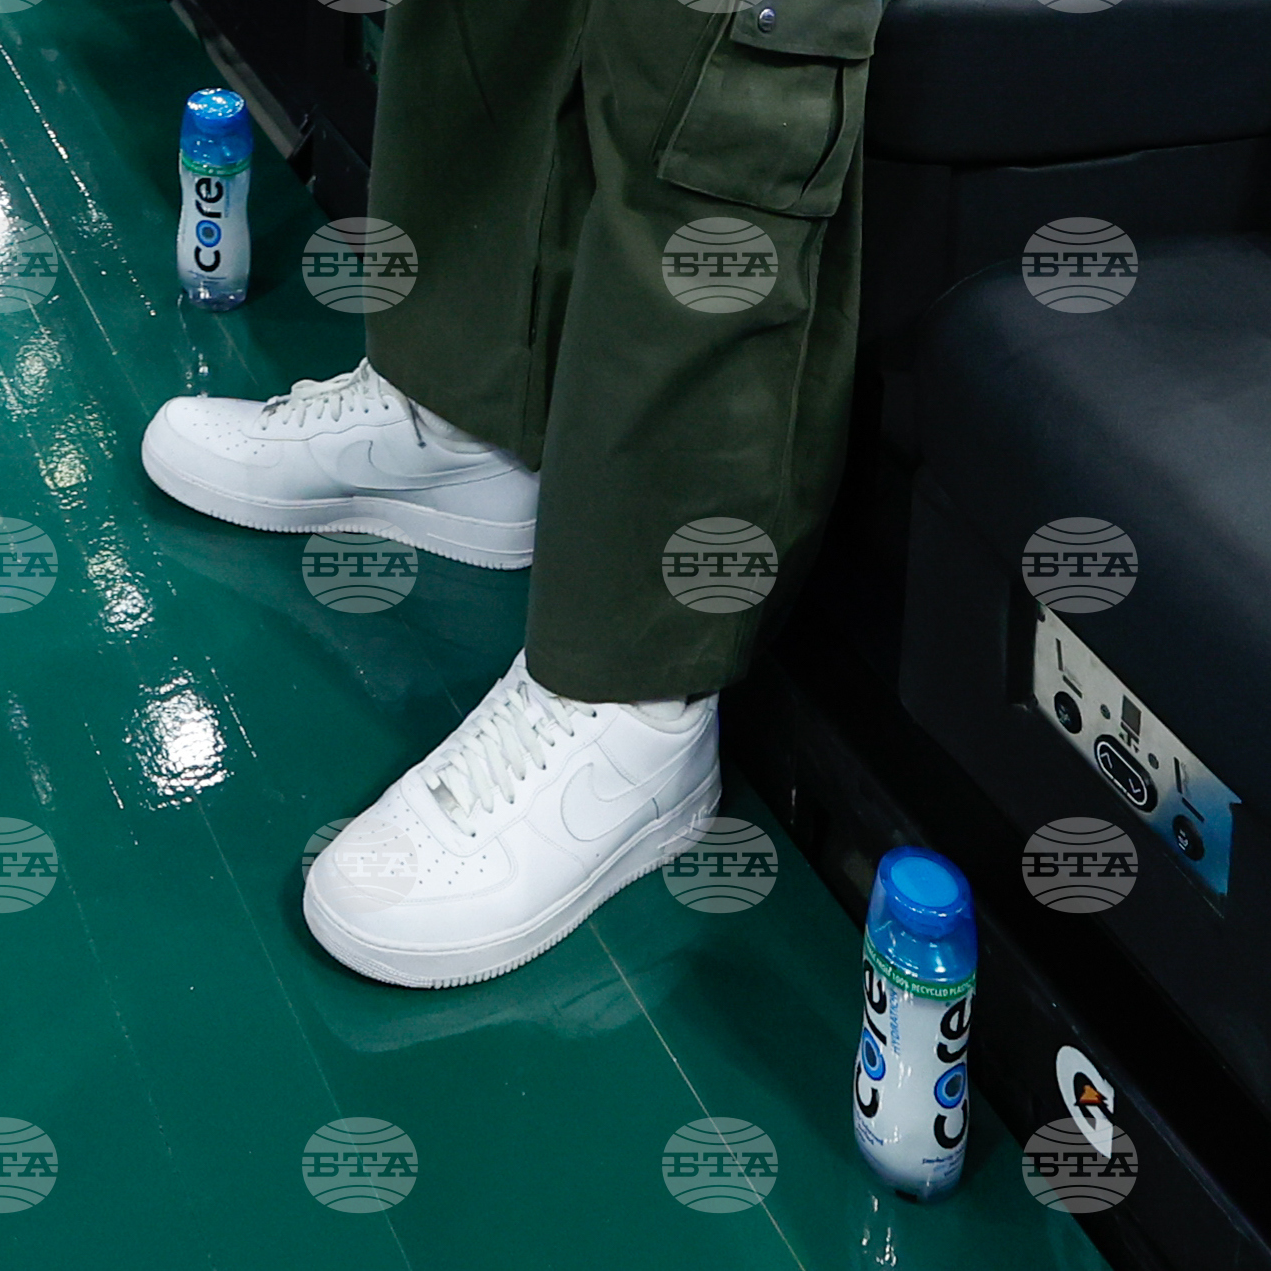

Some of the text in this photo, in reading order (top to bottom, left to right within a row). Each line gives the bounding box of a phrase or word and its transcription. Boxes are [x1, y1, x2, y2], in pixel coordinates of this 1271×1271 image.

[193, 177, 224, 272] core
[855, 959, 887, 1119] core
[933, 995, 975, 1149] core
